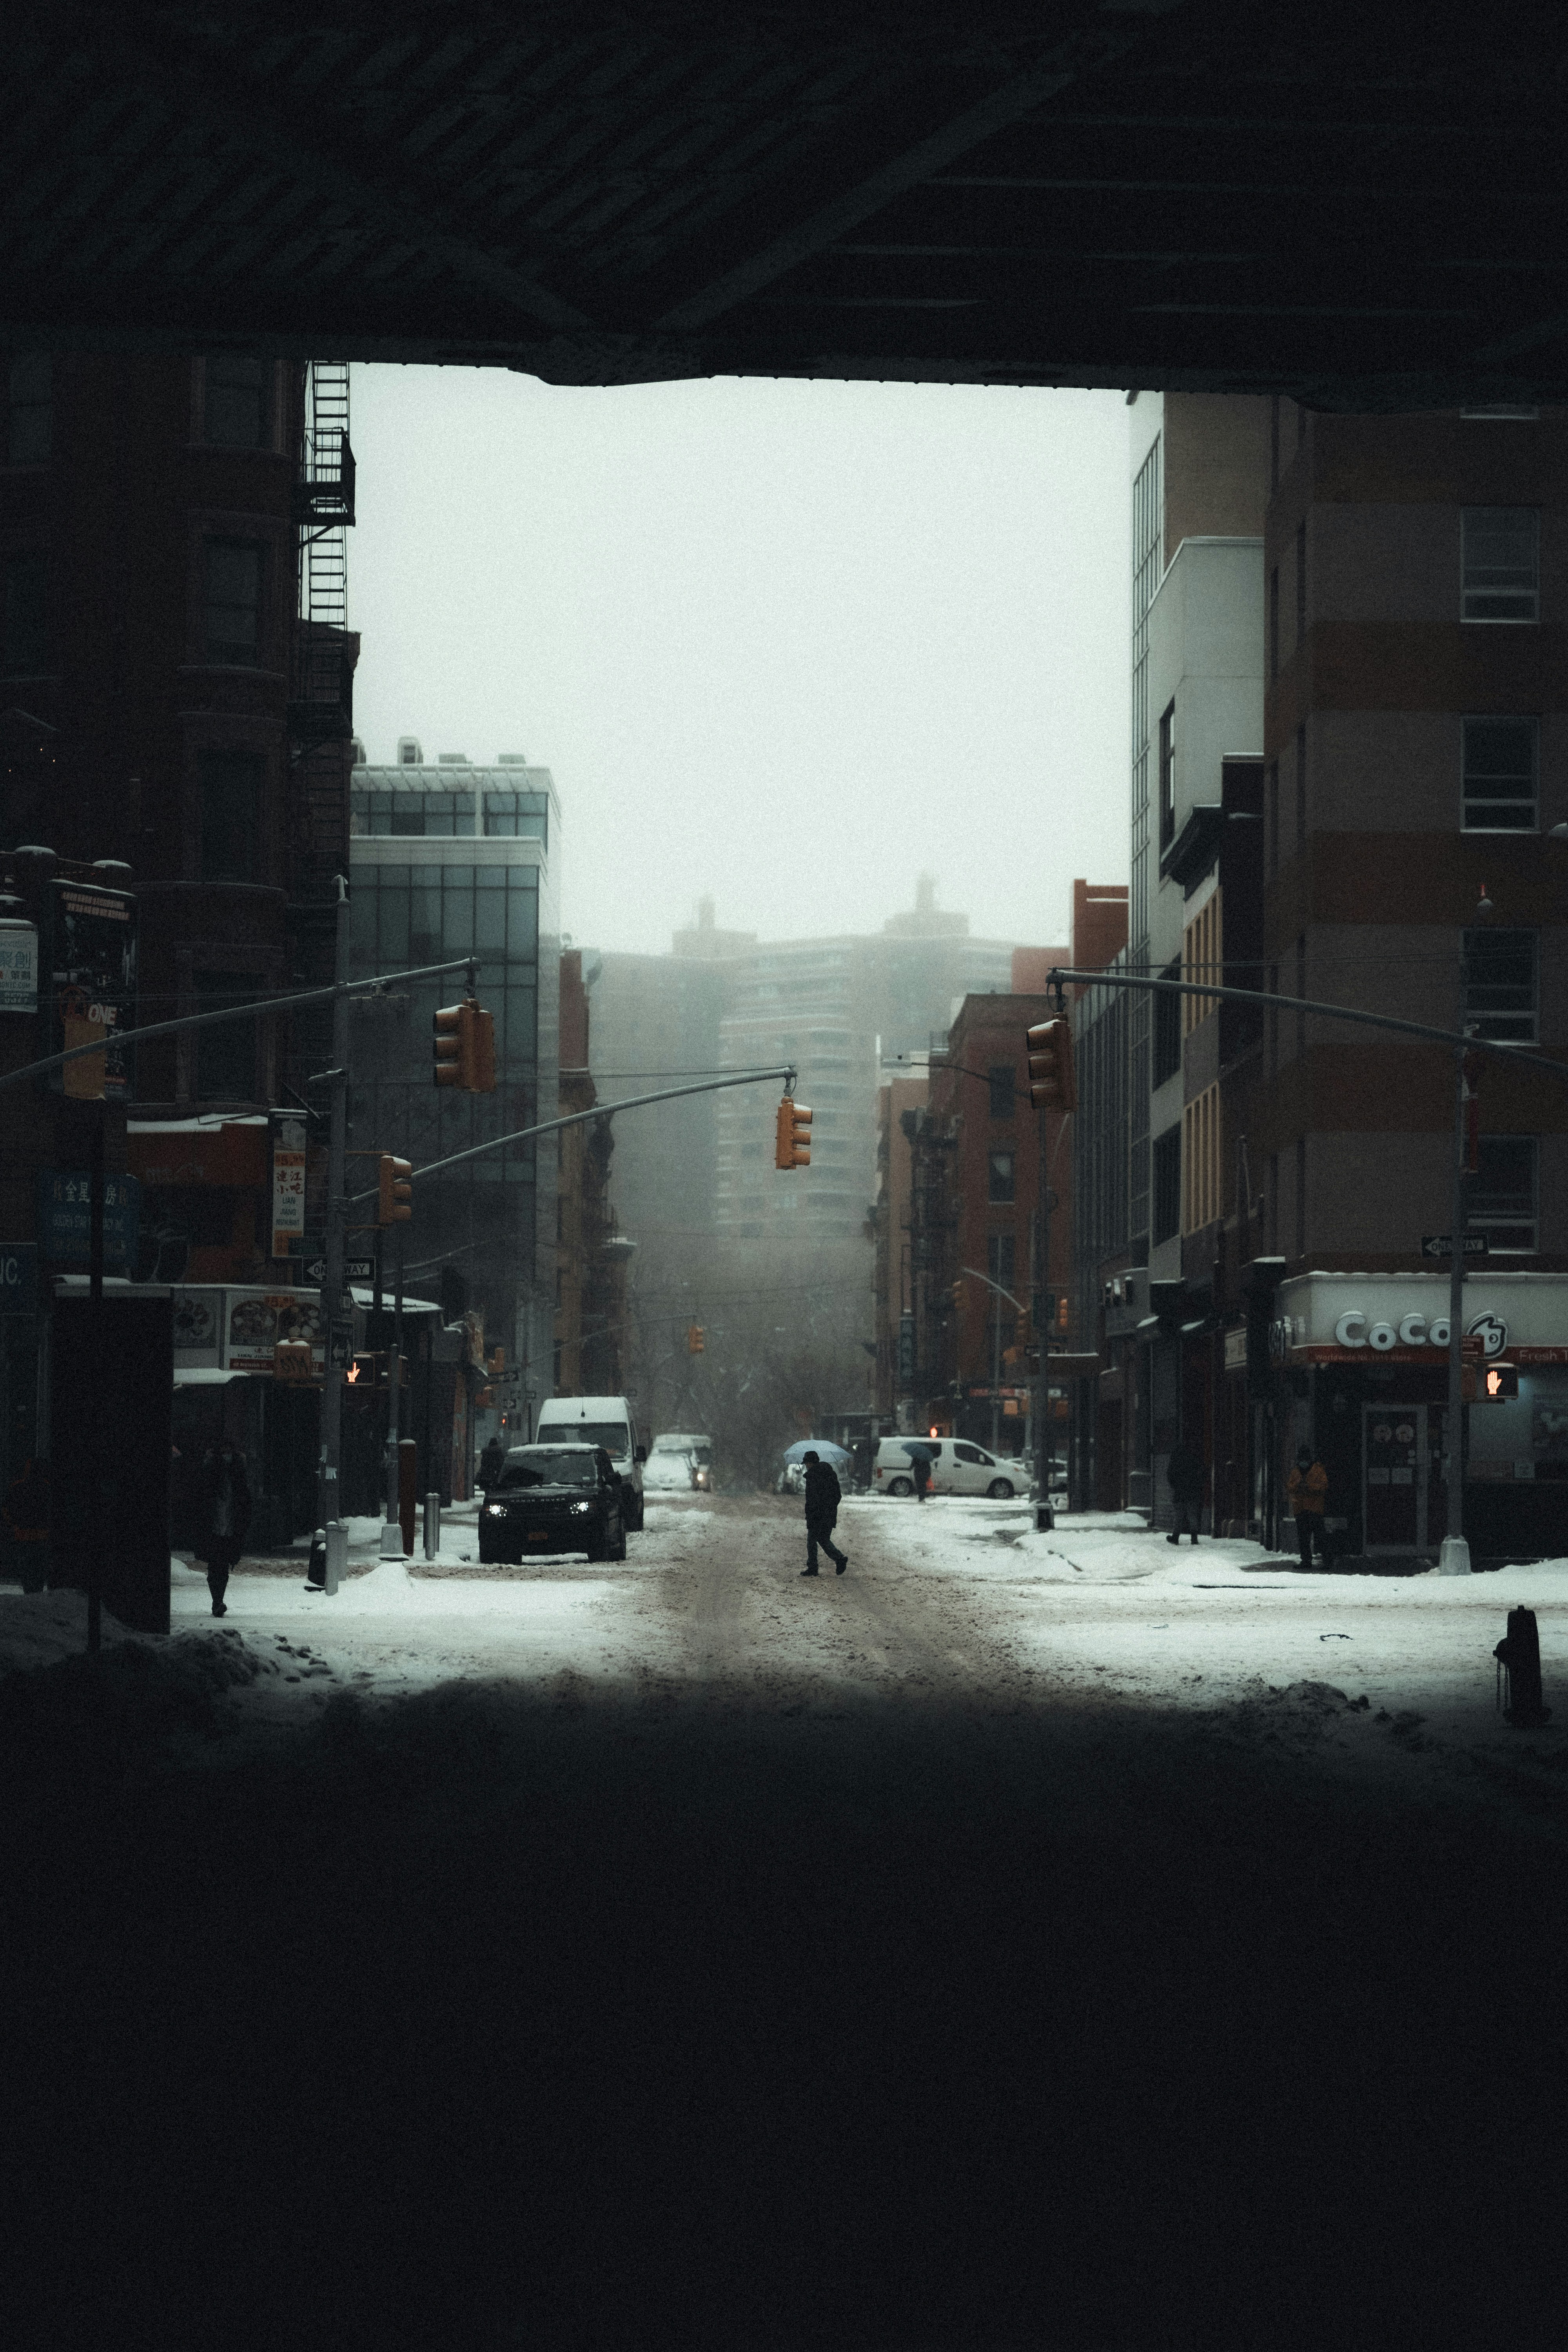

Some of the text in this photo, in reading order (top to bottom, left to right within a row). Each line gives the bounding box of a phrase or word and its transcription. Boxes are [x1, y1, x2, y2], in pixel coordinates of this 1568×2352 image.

[282, 1196, 296, 1205] LIAN
[314, 1264, 365, 1274] ON WAY
[1519, 1349, 1557, 1361] Fresh
